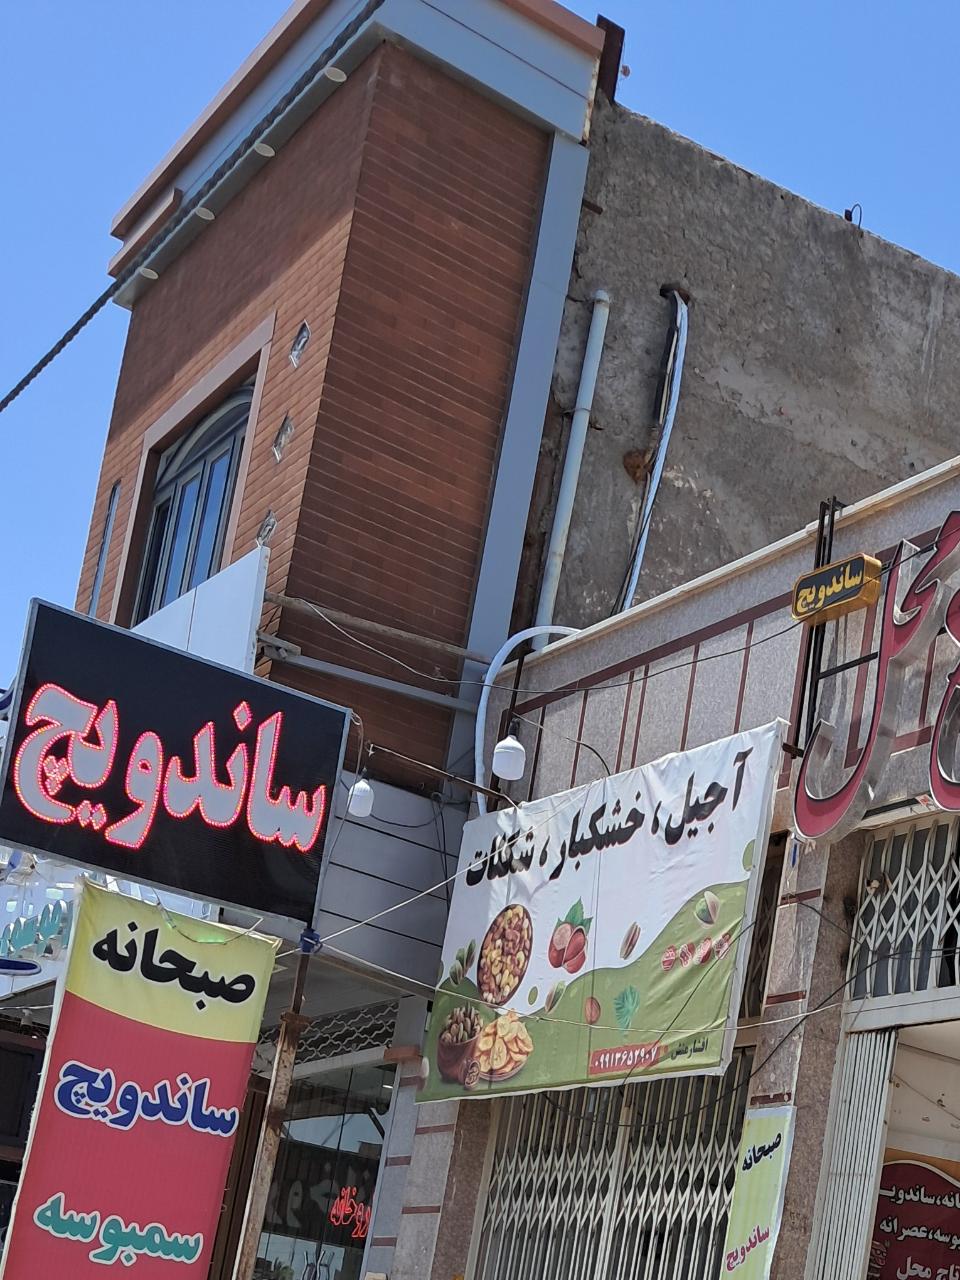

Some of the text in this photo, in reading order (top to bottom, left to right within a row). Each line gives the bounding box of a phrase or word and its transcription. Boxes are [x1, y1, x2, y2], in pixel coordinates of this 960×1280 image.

[797, 563, 862, 613] ساندویچ
[14, 683, 326, 852] ساندویچ
[91, 921, 256, 1011] صبحانه
[54, 1060, 238, 1137] ساندویچ
[742, 1132, 782, 1171] صبحانه
[880, 1185, 935, 1204] ساندوی
[33, 1192, 203, 1266] سمبوسه
[897, 1256, 931, 1280] محل
